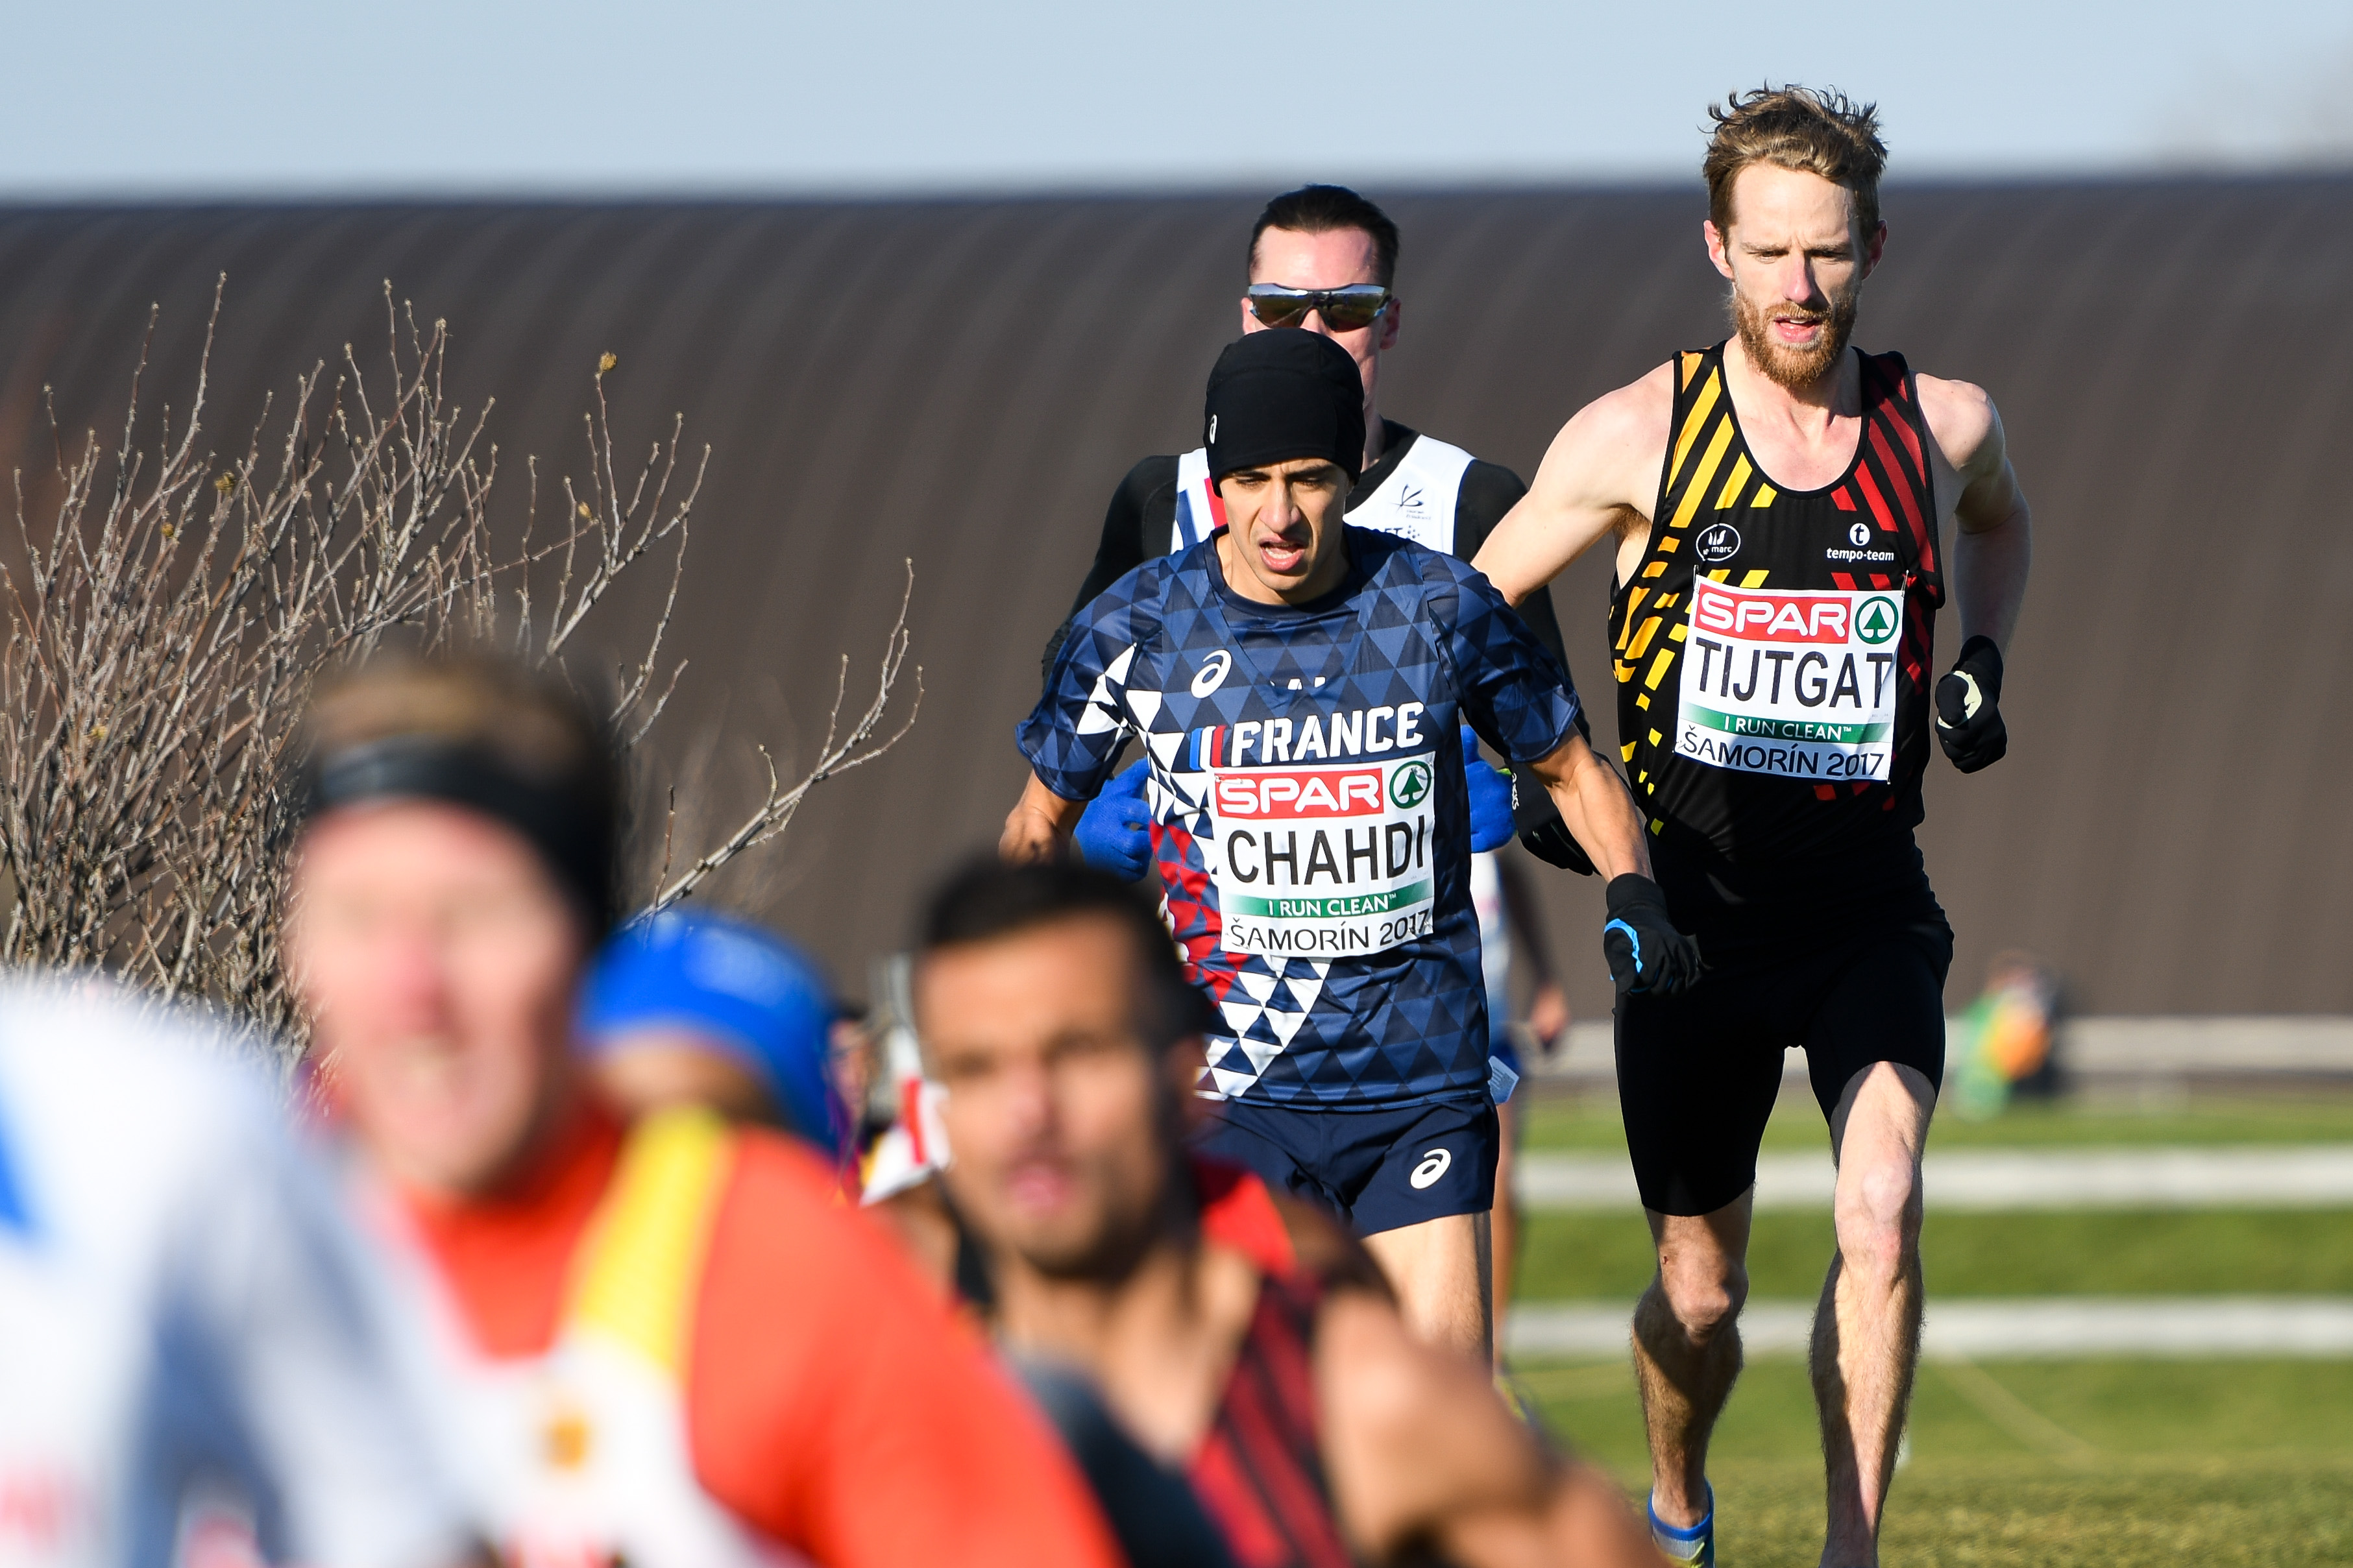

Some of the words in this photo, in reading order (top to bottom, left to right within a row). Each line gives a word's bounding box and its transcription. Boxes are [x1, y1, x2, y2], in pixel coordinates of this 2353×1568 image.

[1700, 592, 1848, 638] SPAR
[1695, 636, 1893, 709] TIJTGAT
[1231, 701, 1424, 767] FRANCE
[1724, 716, 1730, 730] I
[1735, 717, 1775, 735] RUN
[1683, 724, 1819, 775] ŠAMORÍN
[1825, 753, 1884, 777] 2017
[1219, 774, 1380, 814] SPAR
[1227, 815, 1426, 886] CHAHDI
[1230, 917, 1369, 951] ŠAMORÍN
[1379, 908, 1430, 947] 2017
[1269, 900, 1273, 916] I
[1280, 900, 1321, 917] RUN
